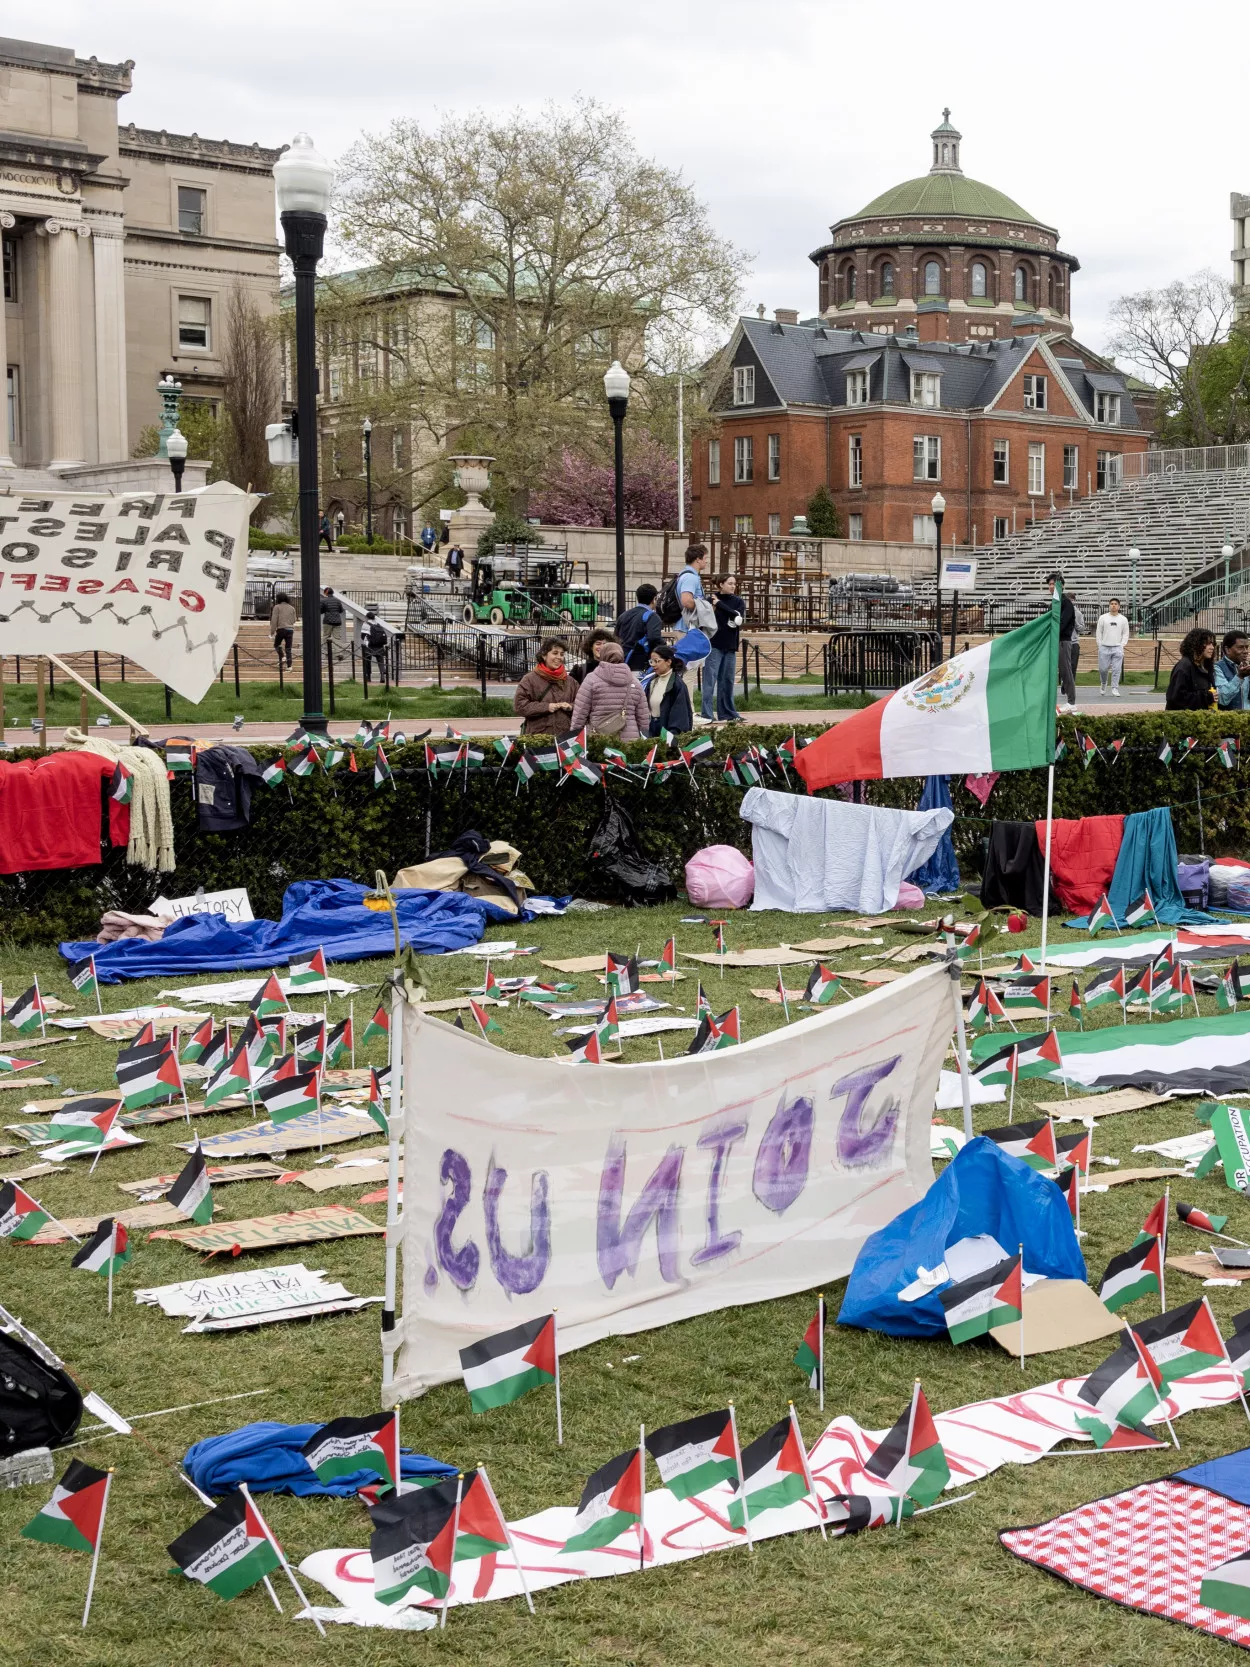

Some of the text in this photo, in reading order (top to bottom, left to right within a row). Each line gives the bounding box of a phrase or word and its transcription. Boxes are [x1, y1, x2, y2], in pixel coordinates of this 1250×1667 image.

[171, 897, 244, 917] HISTORY
[177, 1215, 375, 1249] PALESTINE
[184, 1277, 301, 1302] PALESTINA
[209, 1290, 323, 1315] PALESTINA
